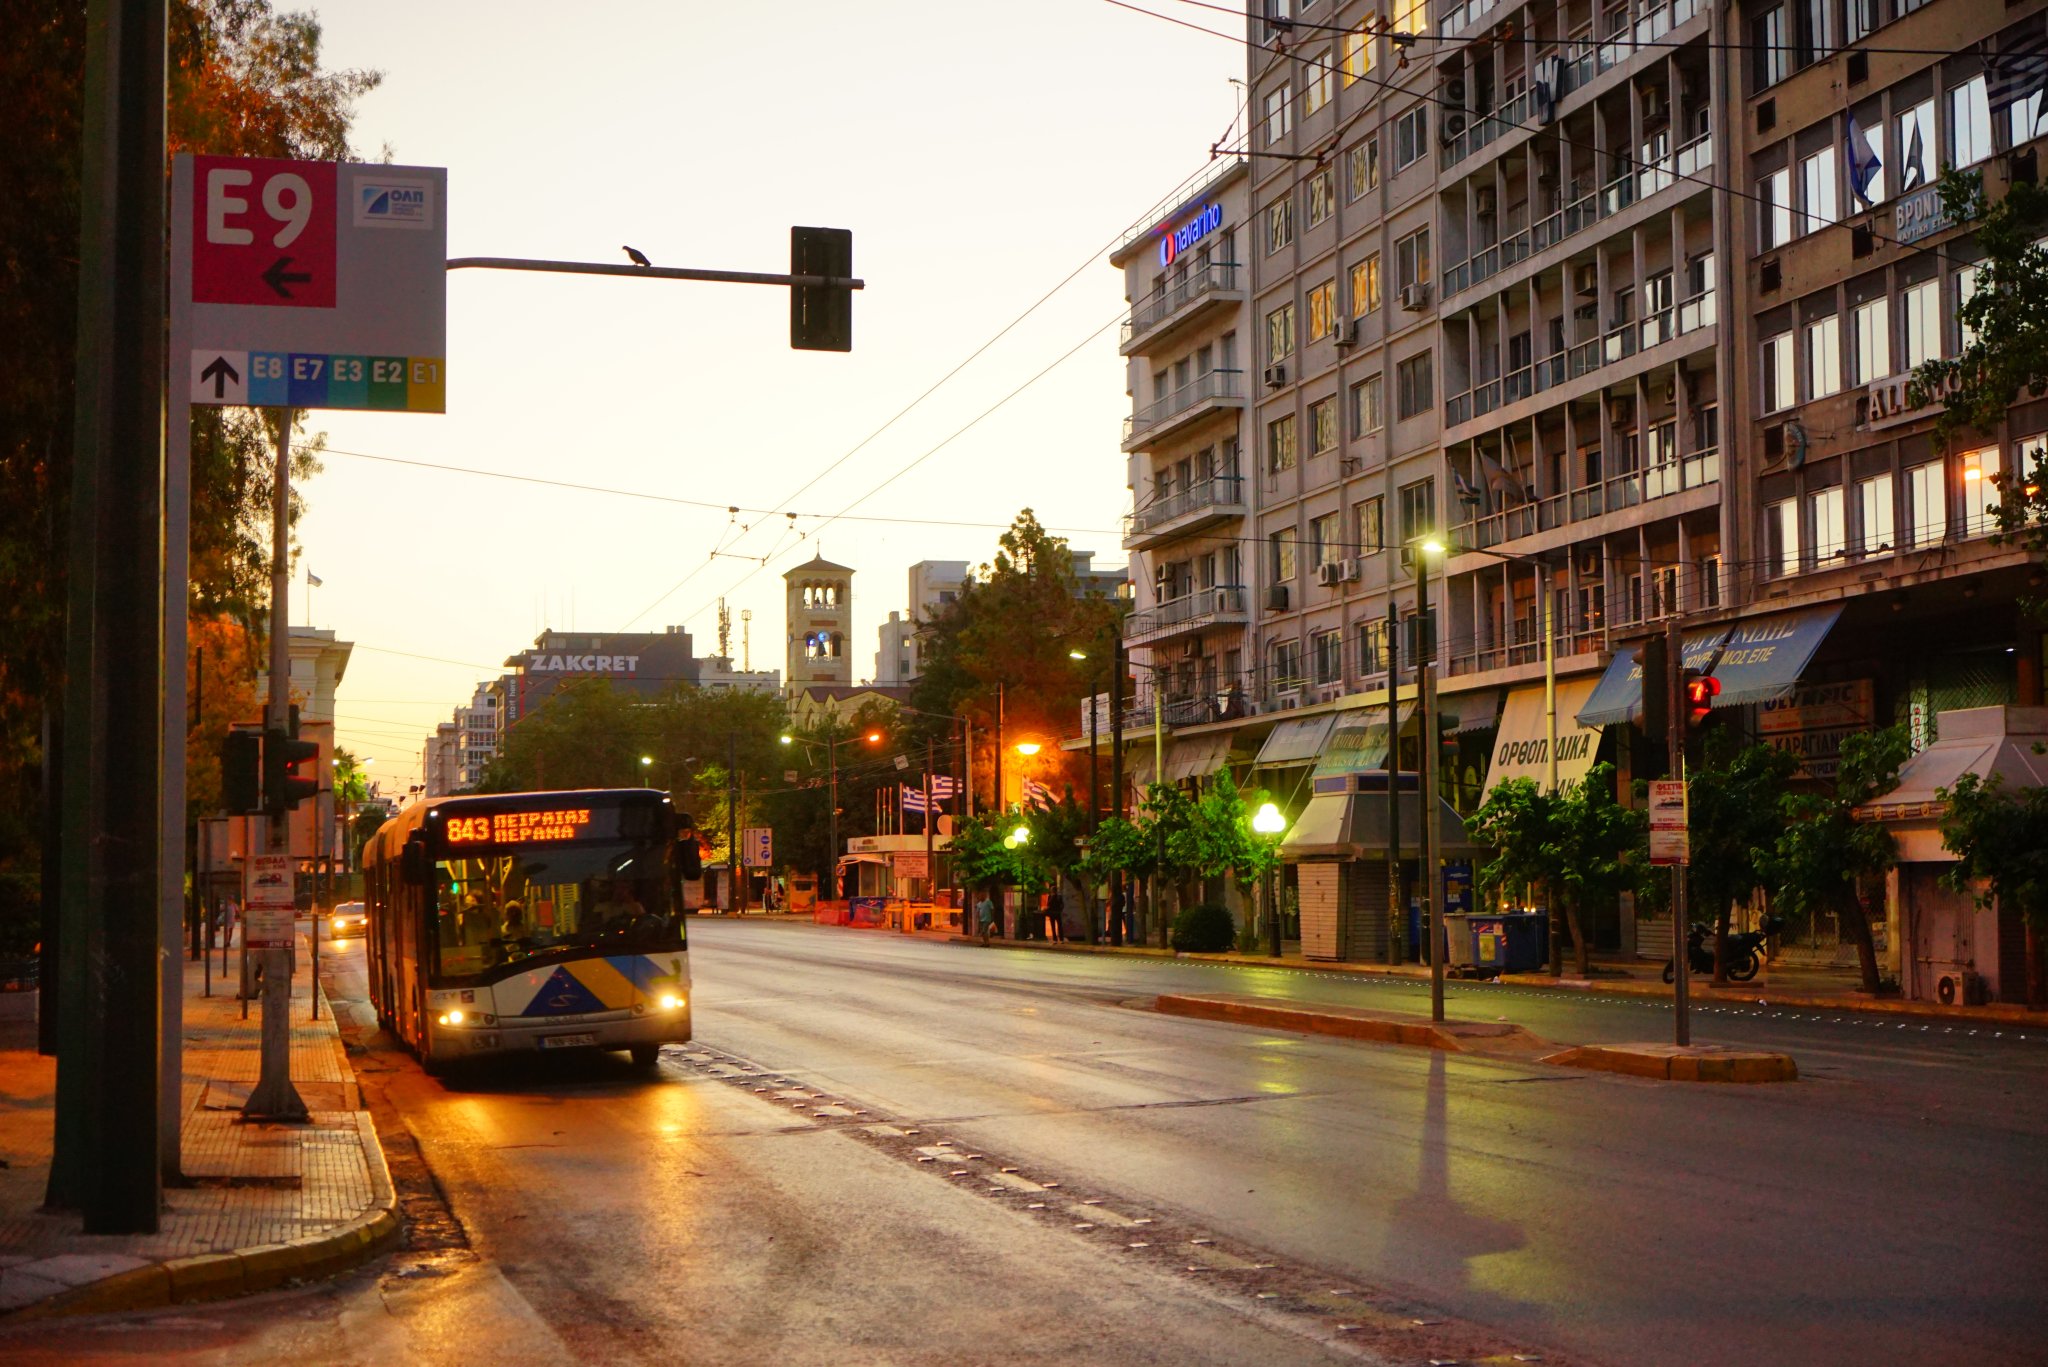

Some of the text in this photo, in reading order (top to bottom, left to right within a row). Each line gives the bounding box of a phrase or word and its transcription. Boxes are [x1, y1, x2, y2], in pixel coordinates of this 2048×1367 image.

[206, 168, 313, 249] E9
[1175, 203, 1222, 256] navarino
[252, 357, 438, 384] E8 E7 E3 E2 E1
[530, 655, 640, 672] ZAKCRET
[1498, 734, 1591, 767] ΟΡΘΟΠΔΙΚΑ
[447, 817, 490, 843] 843
[493, 809, 591, 829] ΠΕΙΡΑΙΑΣ
[494, 825, 575, 843] ΠΕΡΑΜΑ
